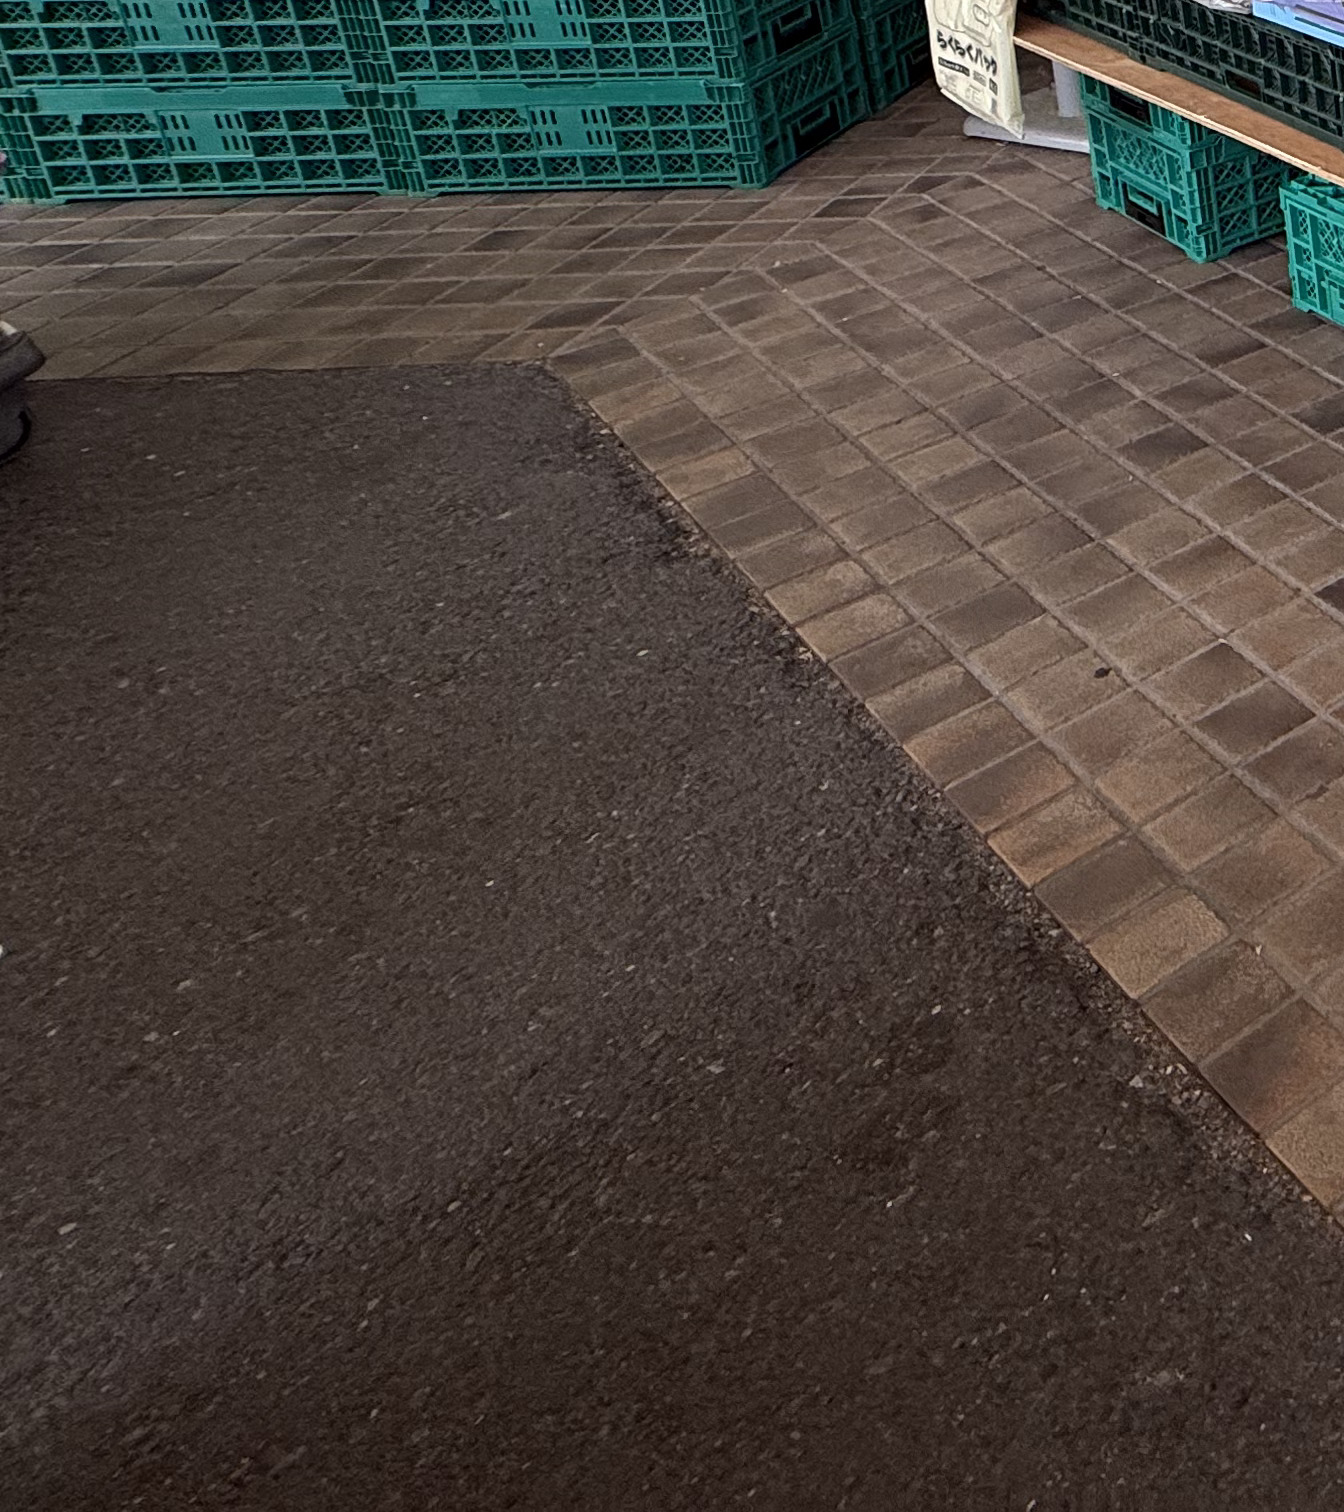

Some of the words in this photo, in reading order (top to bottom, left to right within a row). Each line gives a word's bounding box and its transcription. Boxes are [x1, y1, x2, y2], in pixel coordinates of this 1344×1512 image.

[936, 28, 998, 78] らくらくパック
